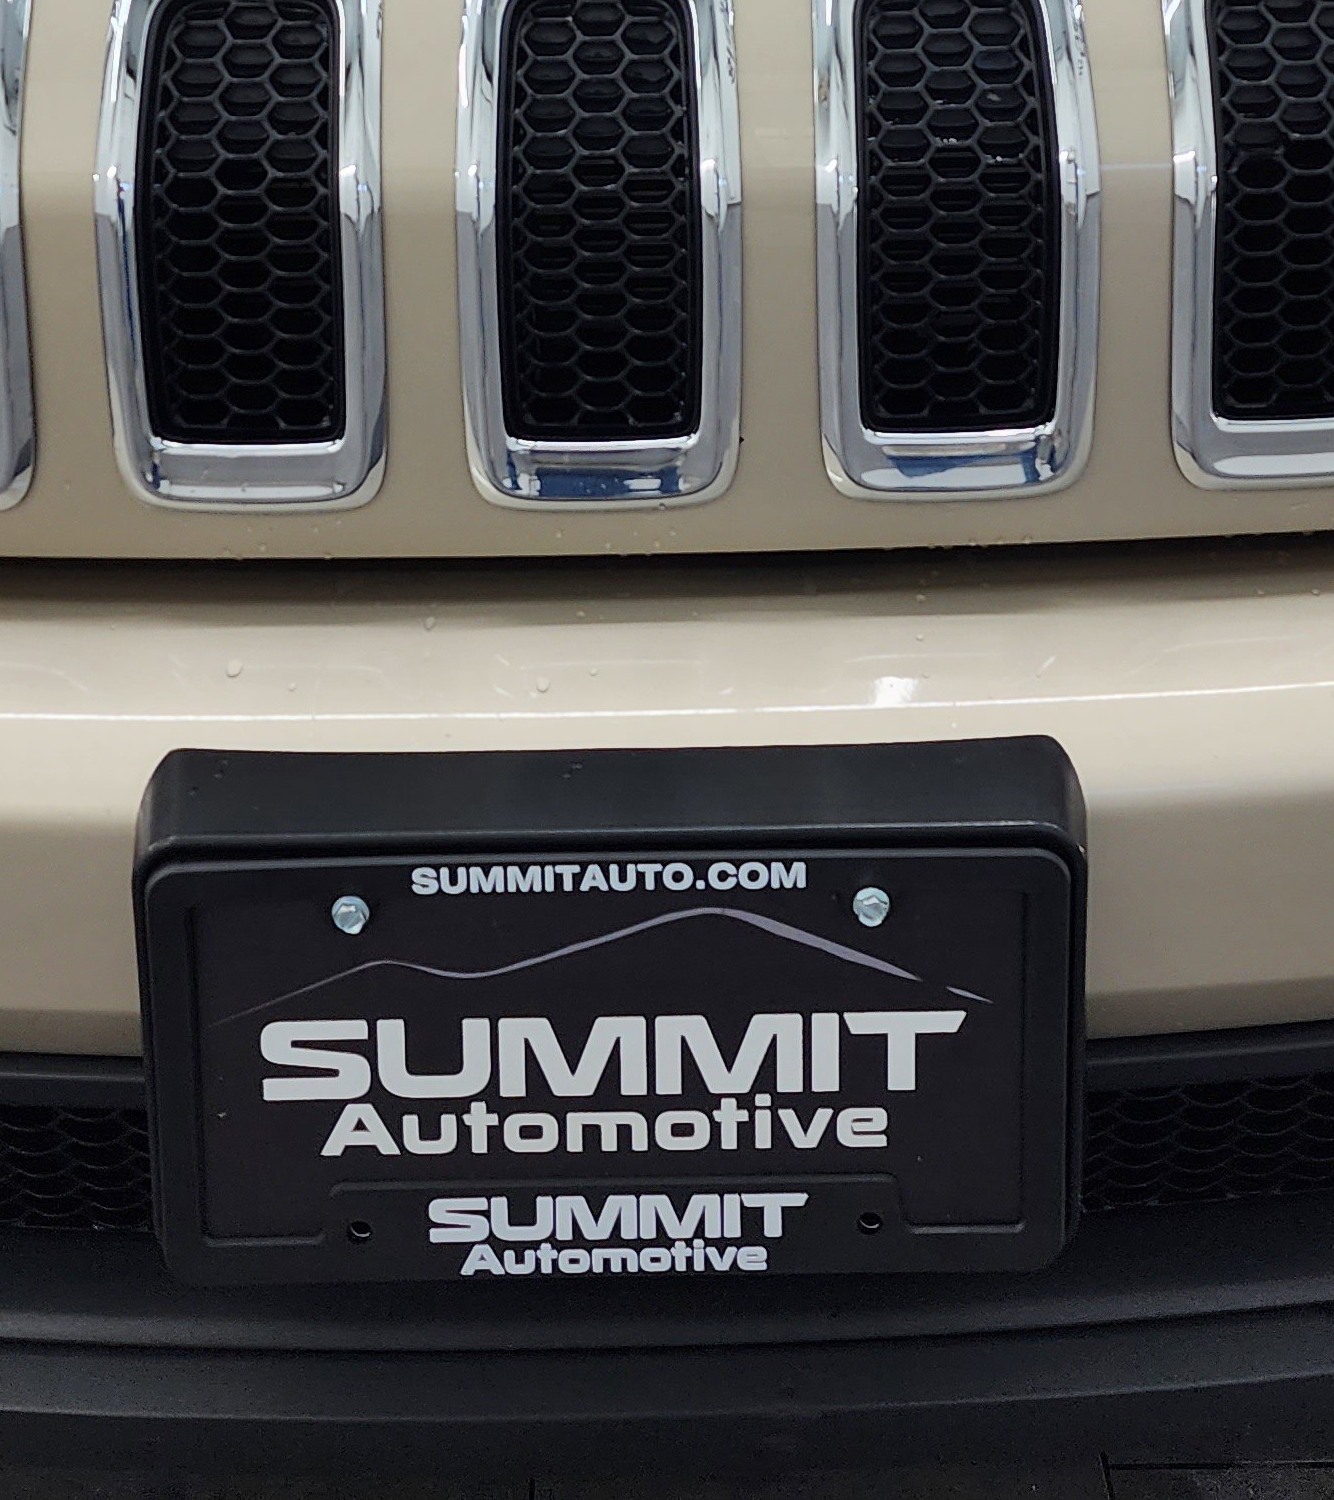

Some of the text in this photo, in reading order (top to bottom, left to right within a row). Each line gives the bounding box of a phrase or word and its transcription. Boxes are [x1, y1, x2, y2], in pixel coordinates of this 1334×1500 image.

[410, 861, 807, 895] SUMMITAUTO.COM
[261, 1010, 967, 1102] SUMMIT
[320, 1095, 889, 1157] Automotive
[428, 1192, 809, 1244] SUMMIT
[460, 1241, 768, 1276] Automotive
